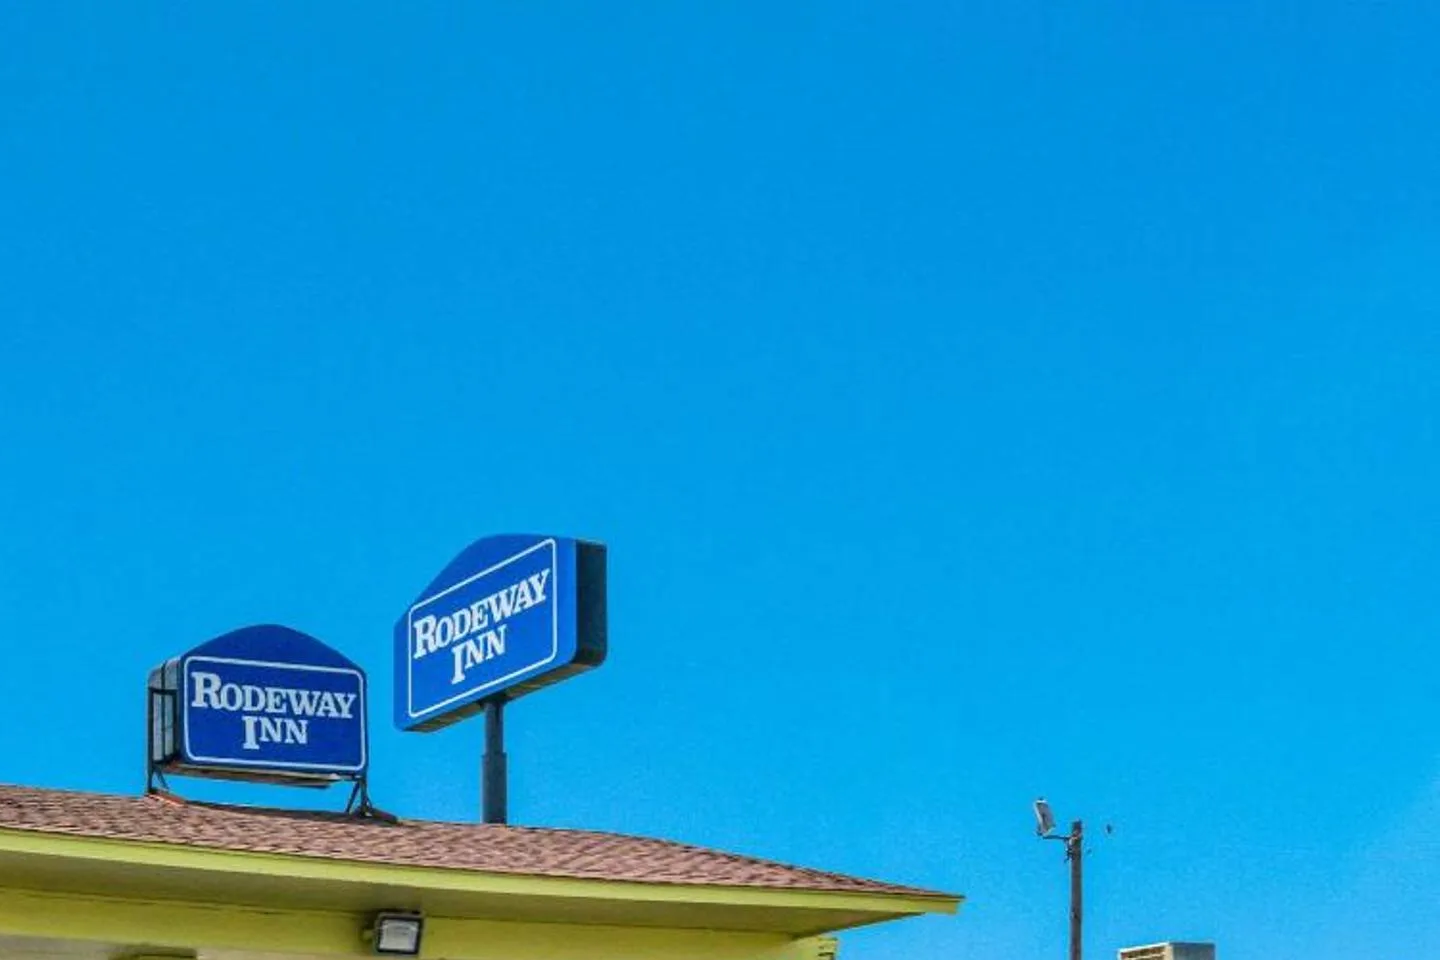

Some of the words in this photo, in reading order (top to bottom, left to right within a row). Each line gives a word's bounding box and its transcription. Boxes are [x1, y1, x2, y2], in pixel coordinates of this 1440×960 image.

[412, 569, 549, 659] RODEWAY
[451, 625, 506, 684] INN
[191, 671, 356, 719] RODEWAY
[242, 715, 308, 749] INN
